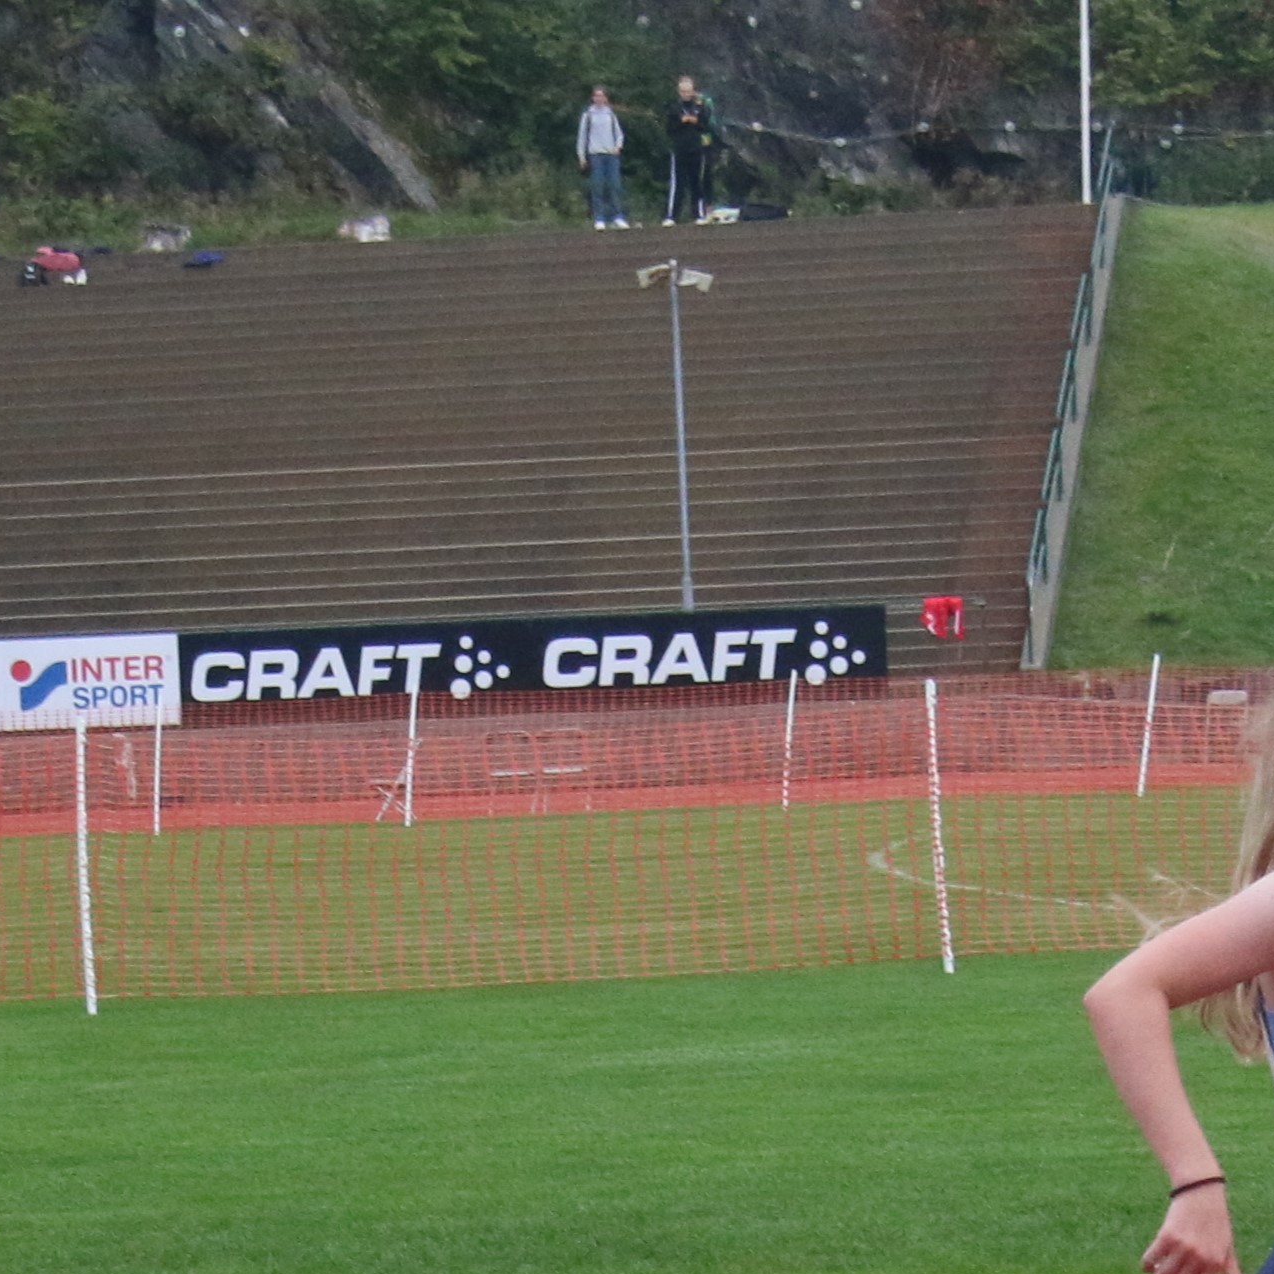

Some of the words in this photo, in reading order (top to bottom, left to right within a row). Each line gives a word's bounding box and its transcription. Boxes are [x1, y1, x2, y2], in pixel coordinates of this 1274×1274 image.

[70, 655, 164, 683] INTER
[191, 643, 442, 703] CRAFT
[542, 628, 798, 691] CRAFT
[73, 683, 164, 710] SPORT
